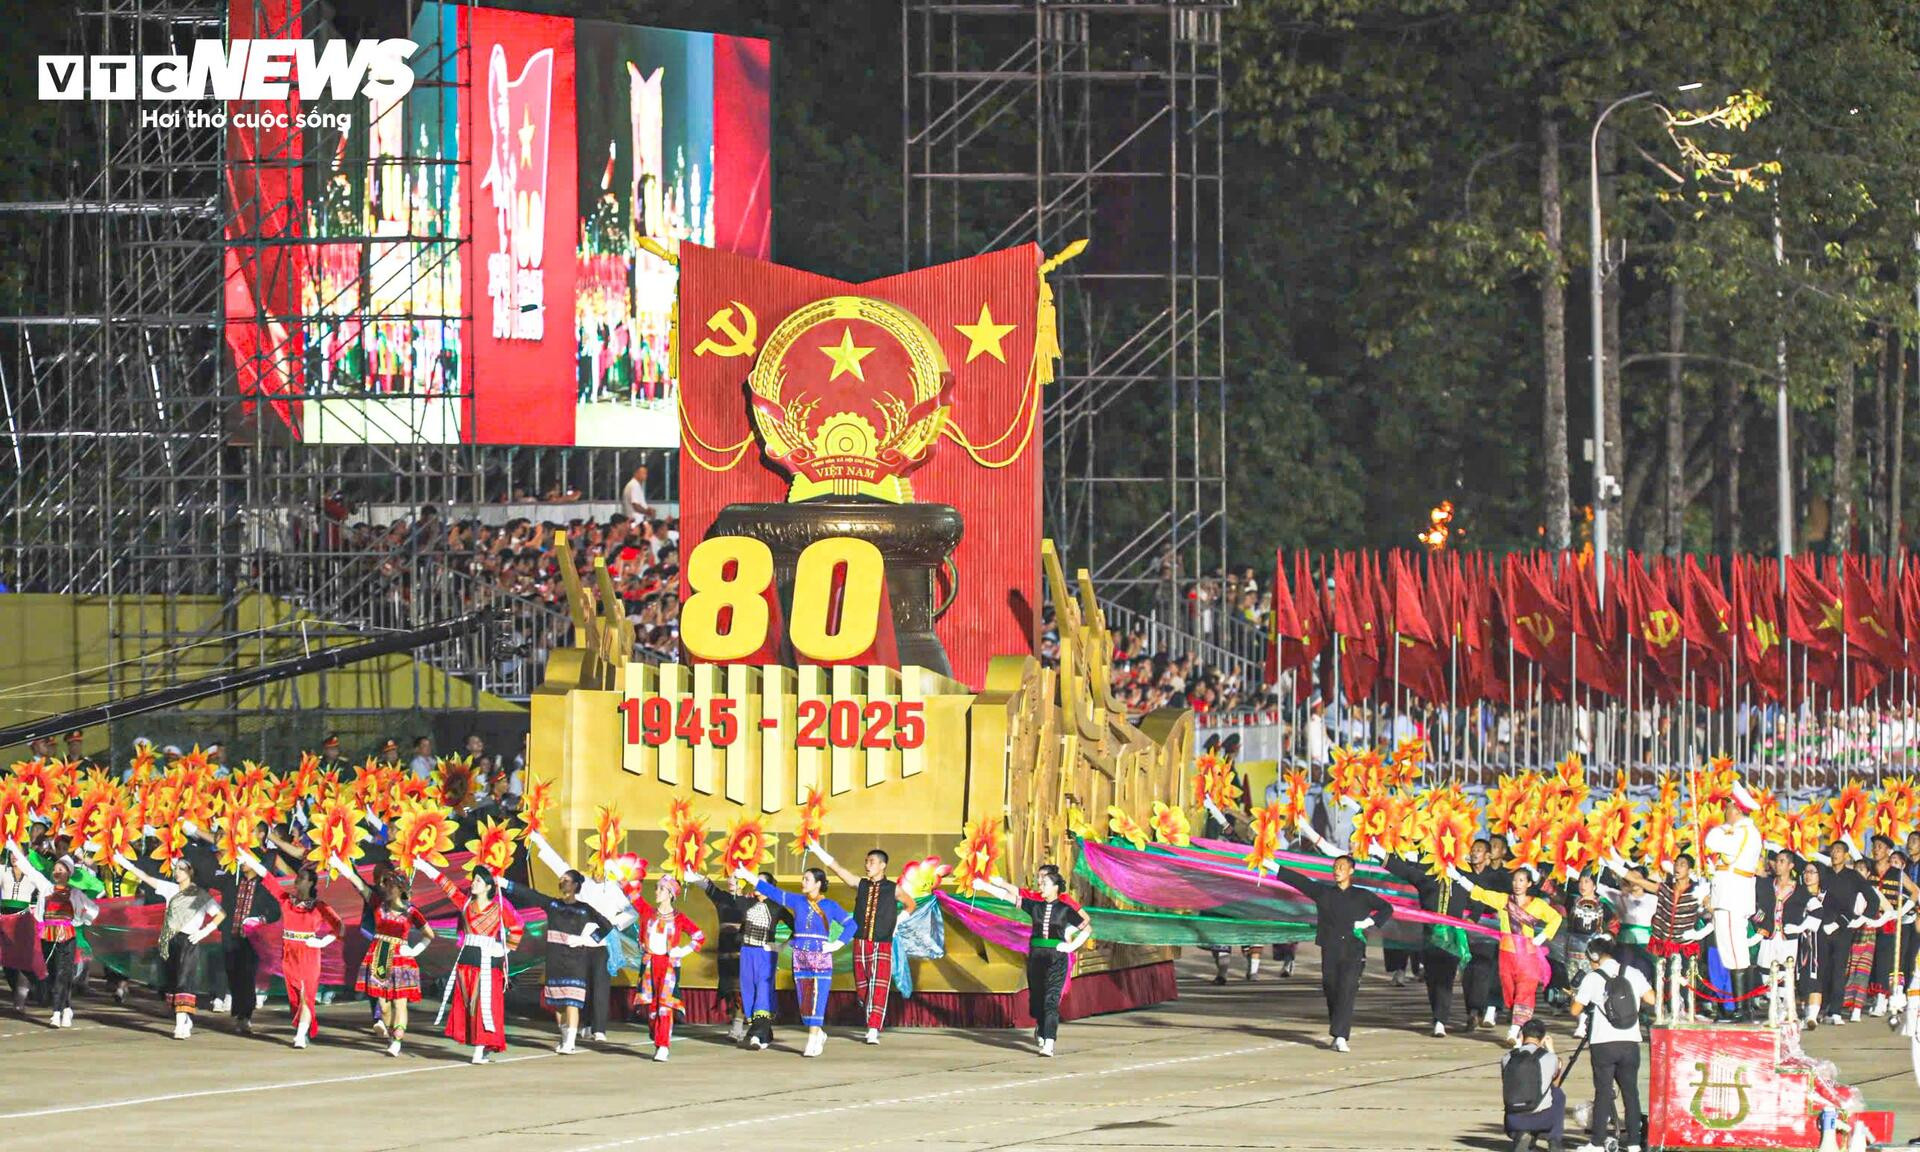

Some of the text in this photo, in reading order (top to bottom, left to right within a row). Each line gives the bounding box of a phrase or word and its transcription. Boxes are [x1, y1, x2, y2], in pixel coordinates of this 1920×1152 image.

[816, 464, 875, 479] VIỆT NAM
[680, 535, 884, 661] 80
[619, 696, 738, 747] 1945
[795, 699, 925, 749] 2025
